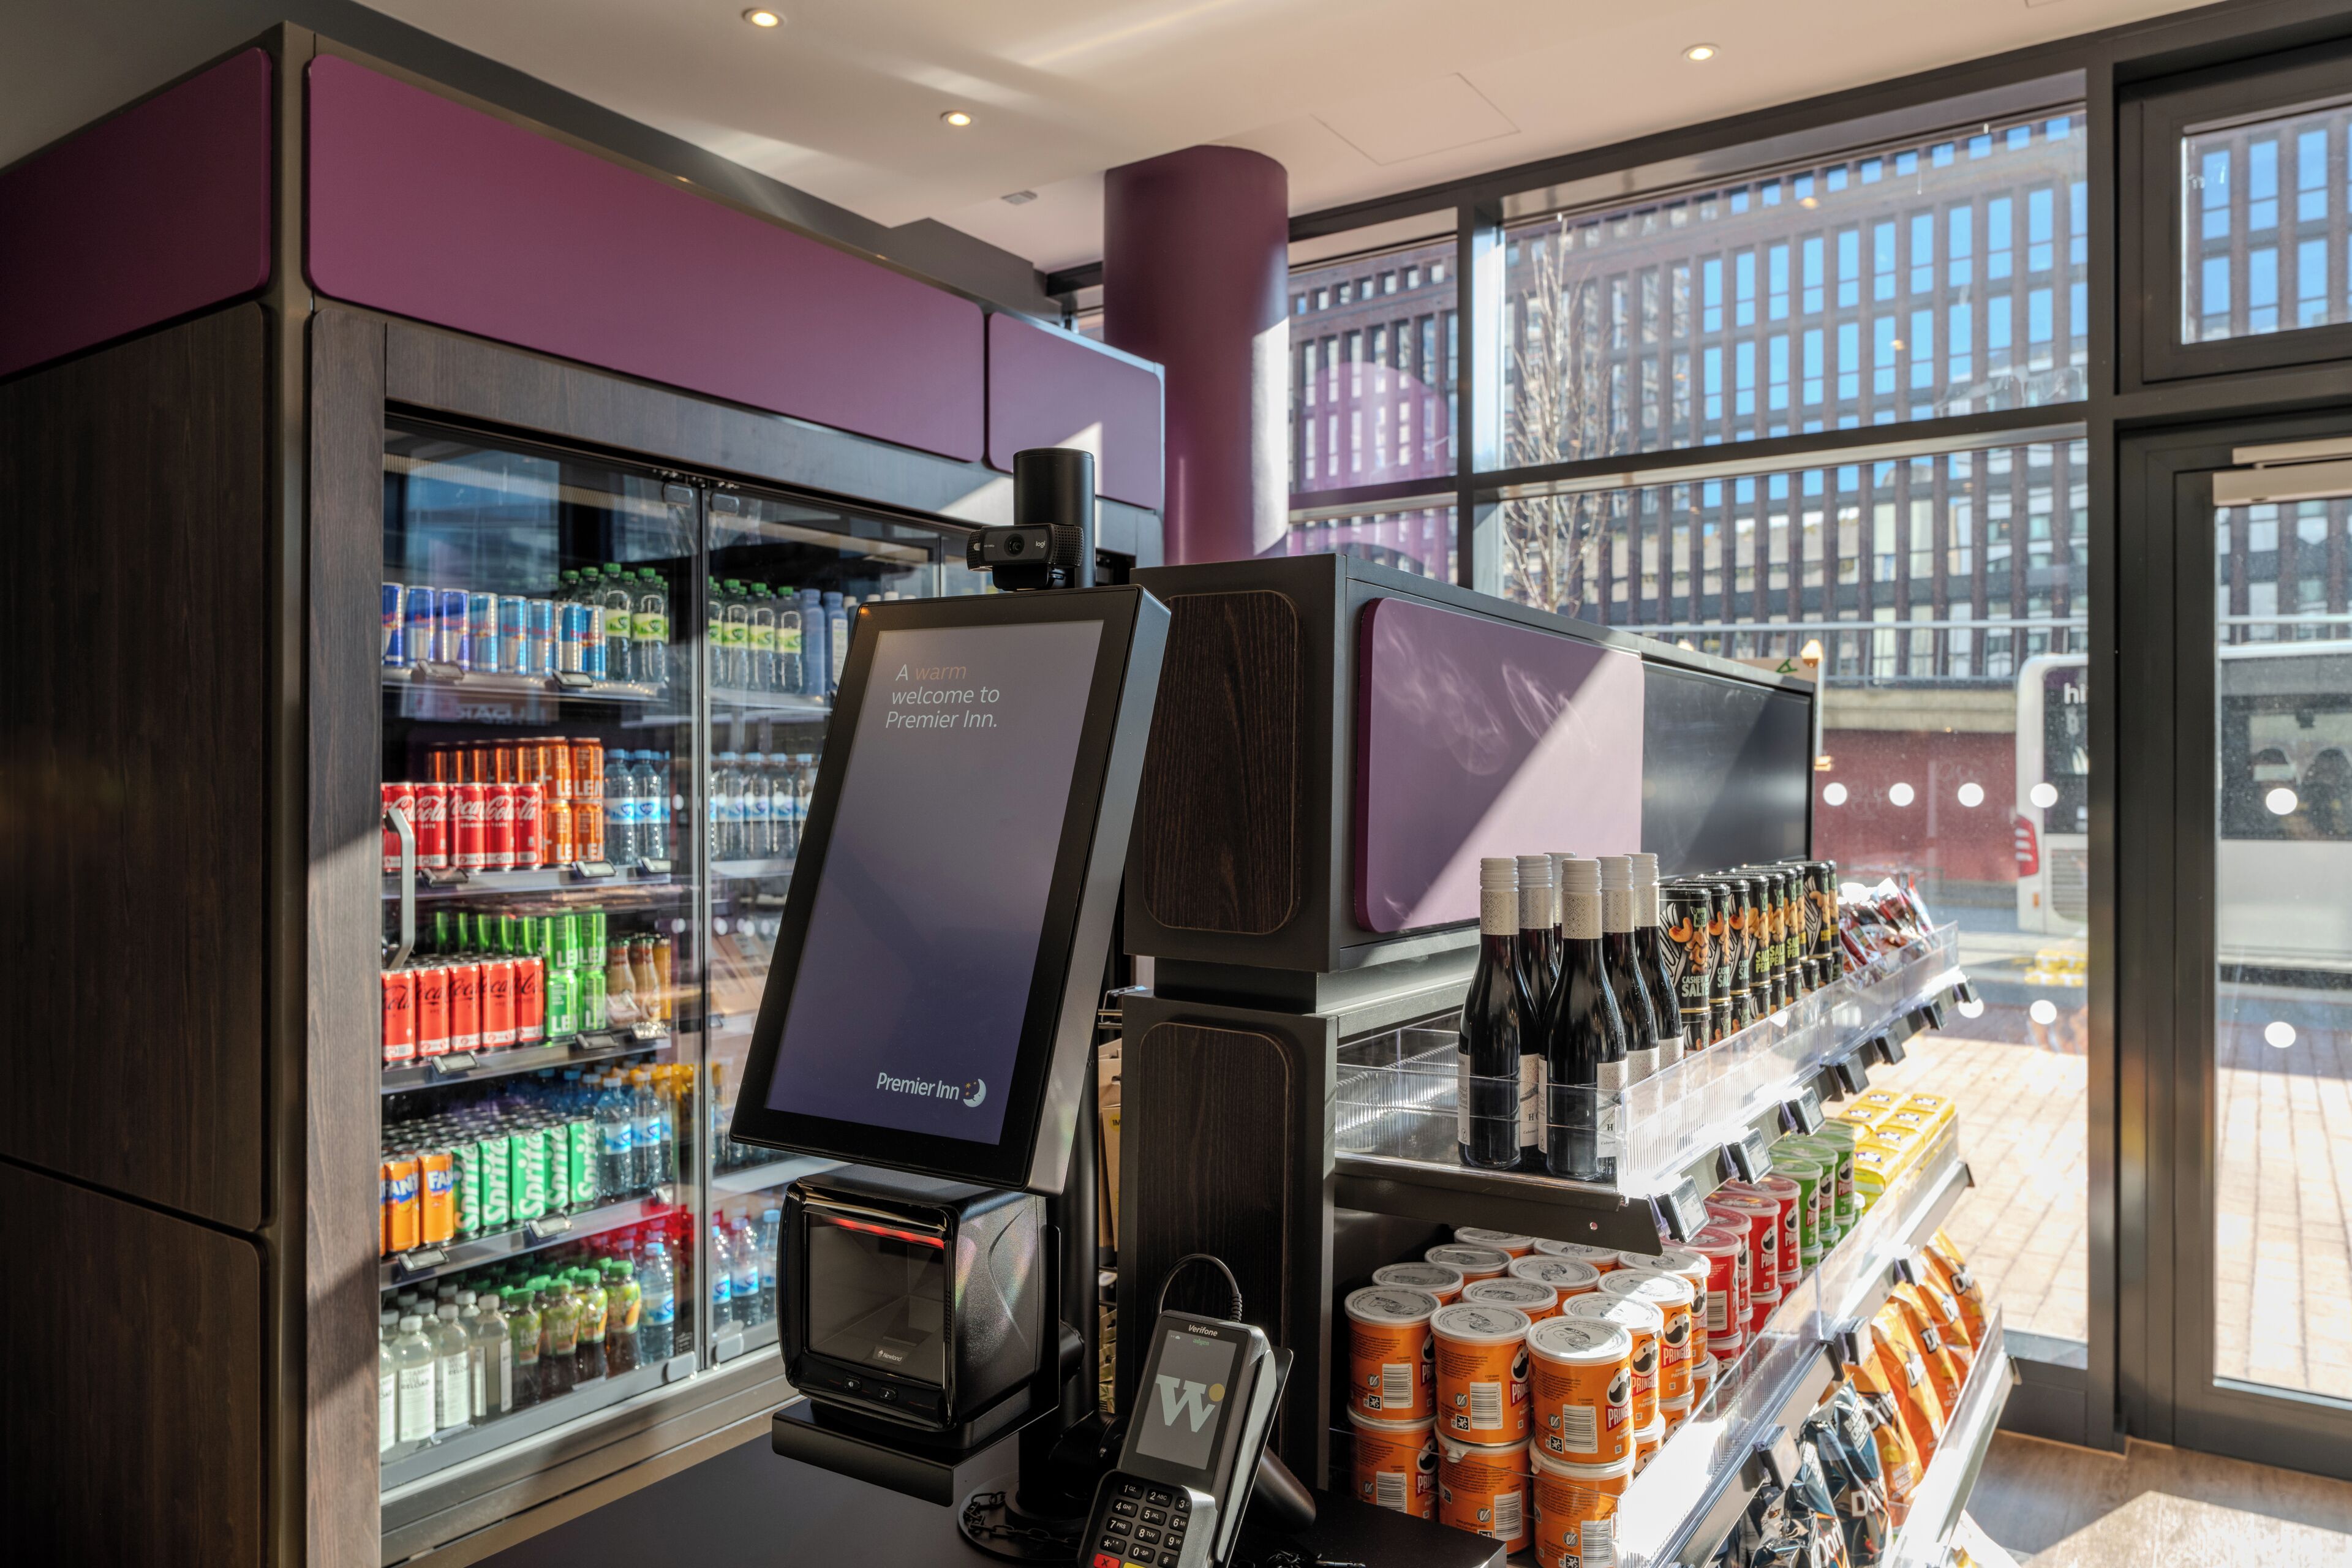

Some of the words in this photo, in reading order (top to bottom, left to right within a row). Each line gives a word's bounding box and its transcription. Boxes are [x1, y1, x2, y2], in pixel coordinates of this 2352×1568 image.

[895, 664, 908, 681] A
[915, 666, 967, 680] warm
[892, 686, 974, 704] welcome
[980, 687, 1000, 703] to
[886, 710, 959, 728] Premier
[963, 710, 997, 728] Inn.
[876, 1072, 935, 1096] Premier
[936, 1080, 960, 1100] Inn
[518, 1132, 545, 1218] Sprite
[1188, 1324, 1218, 1336] Verifone
[883, 1352, 903, 1362] Newland
[1155, 1374, 1215, 1433] W
[1150, 1491, 1156, 1500] 2
[1115, 1502, 1122, 1511] 4
[1178, 1500, 1185, 1509] 3
[1144, 1510, 1150, 1519] 5
[1110, 1520, 1117, 1529] 7
[1173, 1518, 1179, 1527] 6
[1139, 1528, 1145, 1537] 8
[1168, 1537, 1174, 1545] 9
[1133, 1547, 1139, 1556] 0
